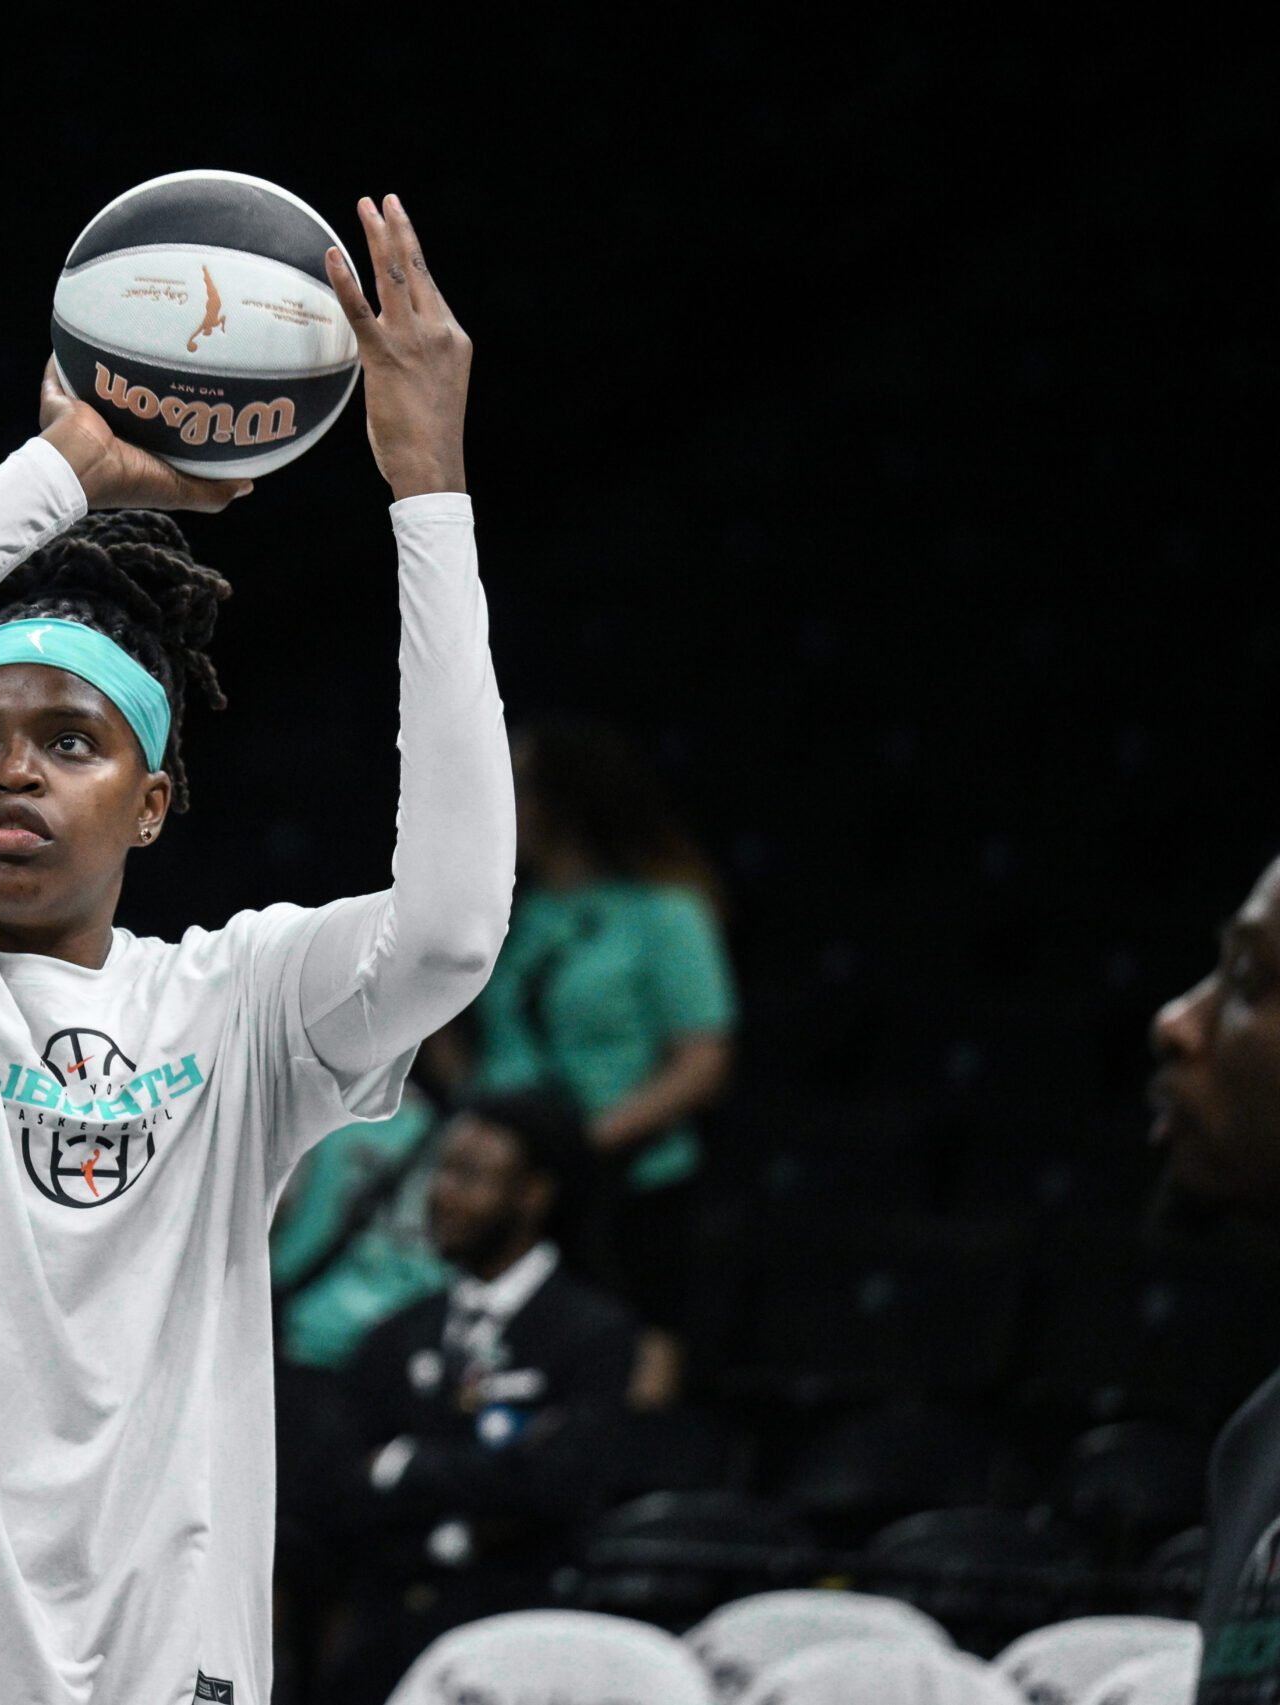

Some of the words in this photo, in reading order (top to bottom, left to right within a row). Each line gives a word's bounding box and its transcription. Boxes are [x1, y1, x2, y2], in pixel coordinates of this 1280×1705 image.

[169, 382, 195, 394] NXT
[200, 386, 225, 397] EVO
[95, 361, 297, 446] Wilson
[3, 1105, 173, 1131] ASKETBALL
